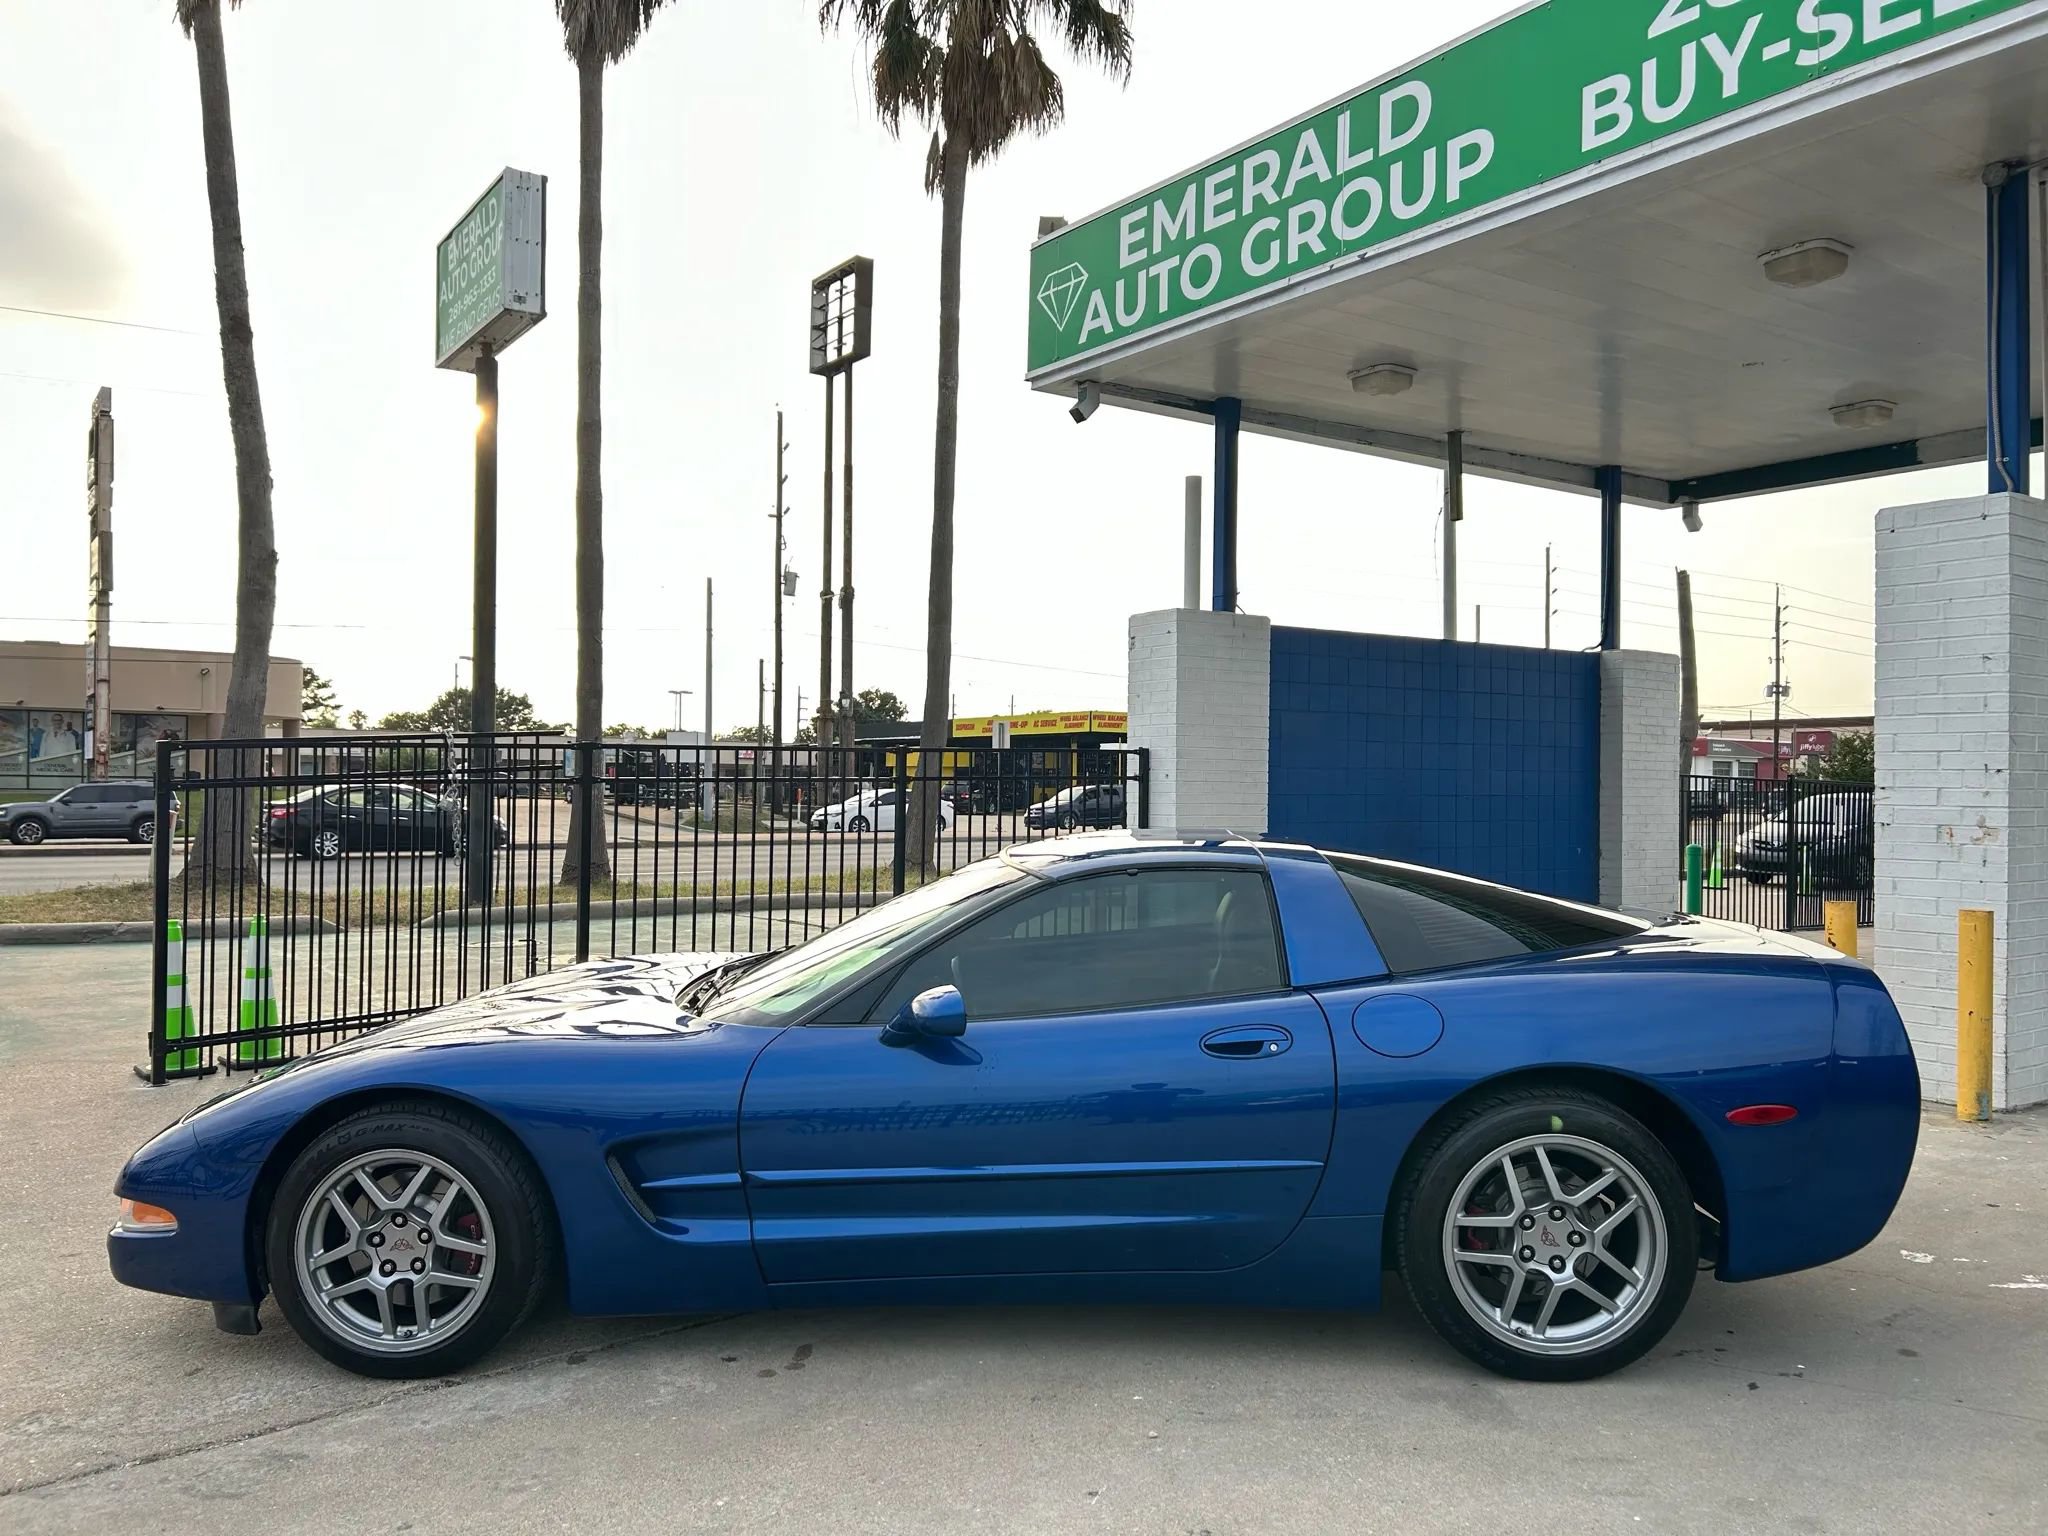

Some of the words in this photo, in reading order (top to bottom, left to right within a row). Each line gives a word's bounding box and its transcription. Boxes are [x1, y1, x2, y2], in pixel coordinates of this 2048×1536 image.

[1581, 0, 1982, 153] BUY-SE
[447, 196, 498, 272] EMERALD
[1119, 80, 1432, 270] EMERALD
[439, 262, 468, 307] AUTO
[470, 219, 503, 279] GROUP
[1078, 242, 1222, 345] AUTO
[1240, 128, 1495, 277] GROUP
[455, 310, 476, 341] FIND
